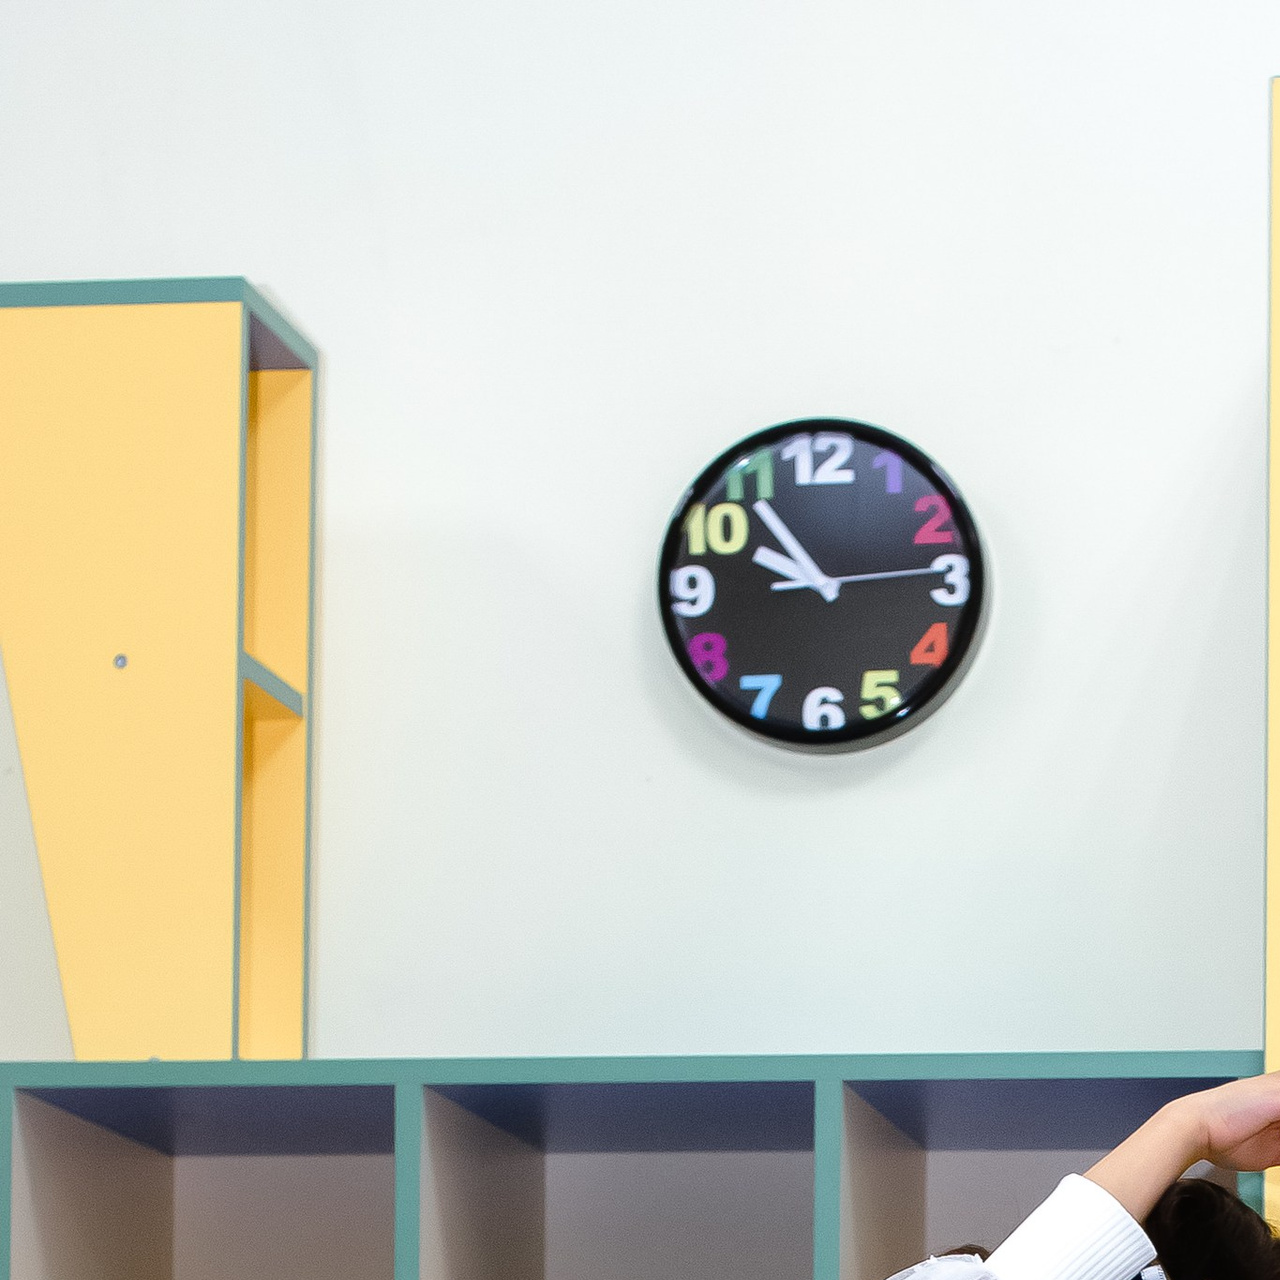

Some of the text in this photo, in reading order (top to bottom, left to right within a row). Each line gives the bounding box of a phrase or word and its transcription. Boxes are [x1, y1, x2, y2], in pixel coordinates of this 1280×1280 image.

[726, 449, 775, 500] 11
[781, 431, 855, 486] 12
[872, 450, 903, 493] 1
[684, 502, 749, 555] 10
[913, 494, 954, 544] 2
[670, 565, 716, 617] 9
[929, 554, 971, 606] 3
[687, 632, 729, 681] 8
[909, 622, 949, 667] 4
[739, 673, 783, 719] 7
[802, 687, 846, 730] 6
[859, 669, 902, 720] 5
